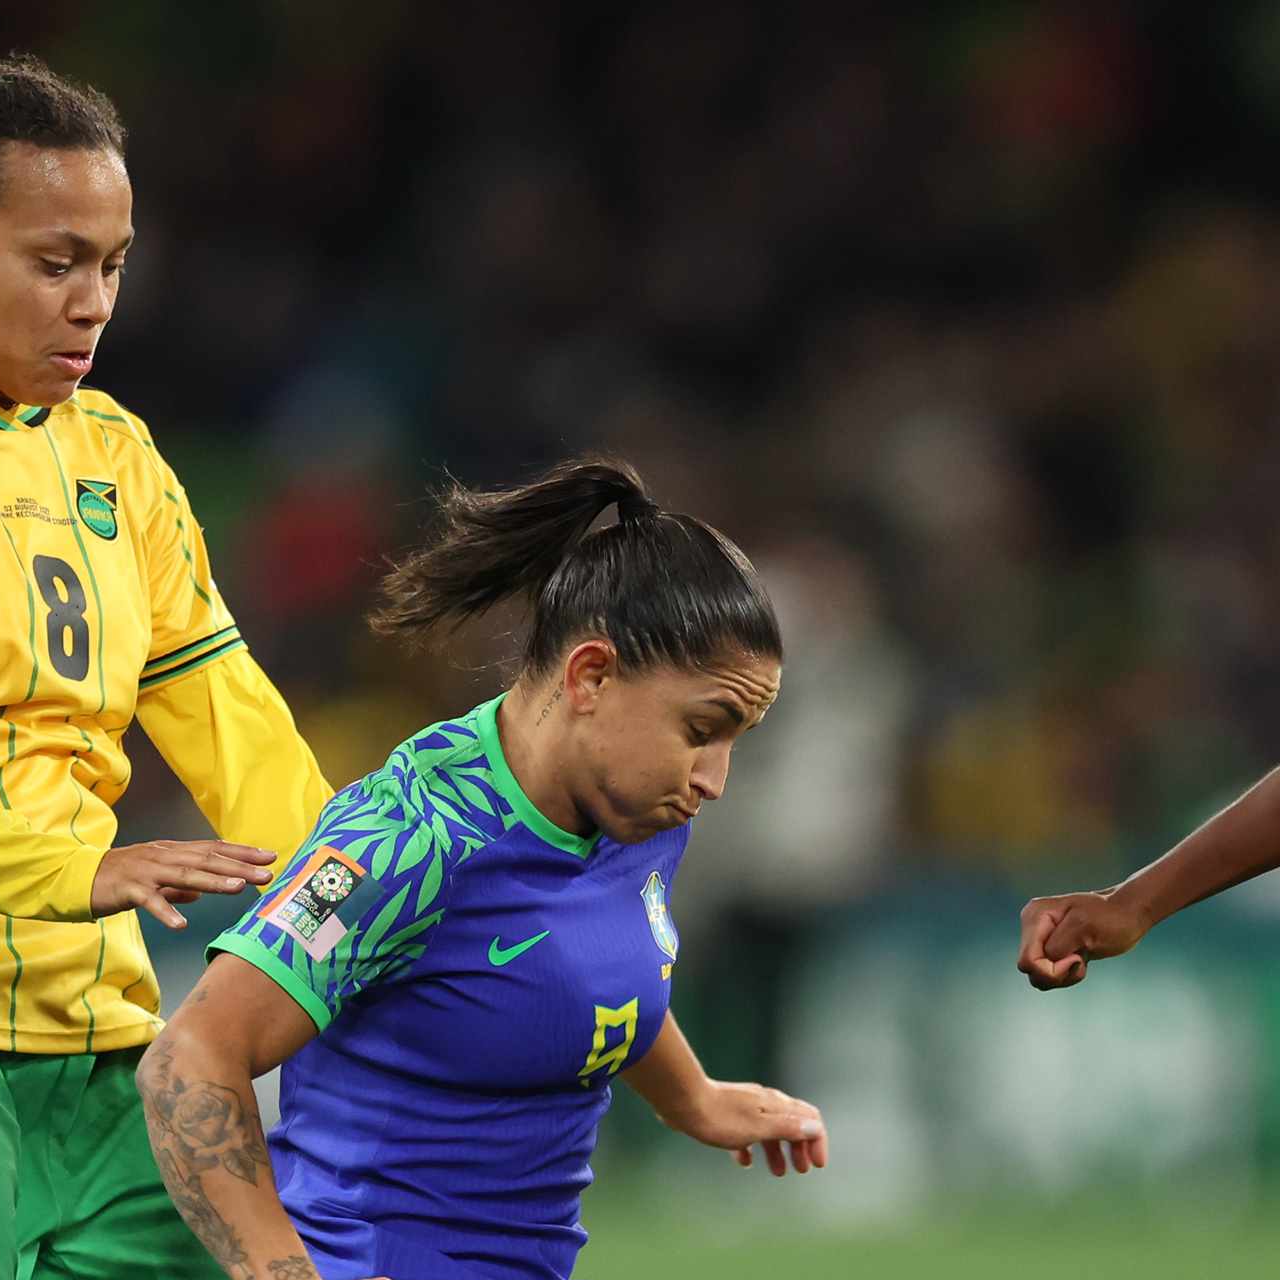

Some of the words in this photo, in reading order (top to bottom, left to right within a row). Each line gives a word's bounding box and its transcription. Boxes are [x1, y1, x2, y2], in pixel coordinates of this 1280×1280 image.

[32, 554, 90, 682] 8
[284, 903, 303, 915] AU
[279, 910, 297, 923] NZ
